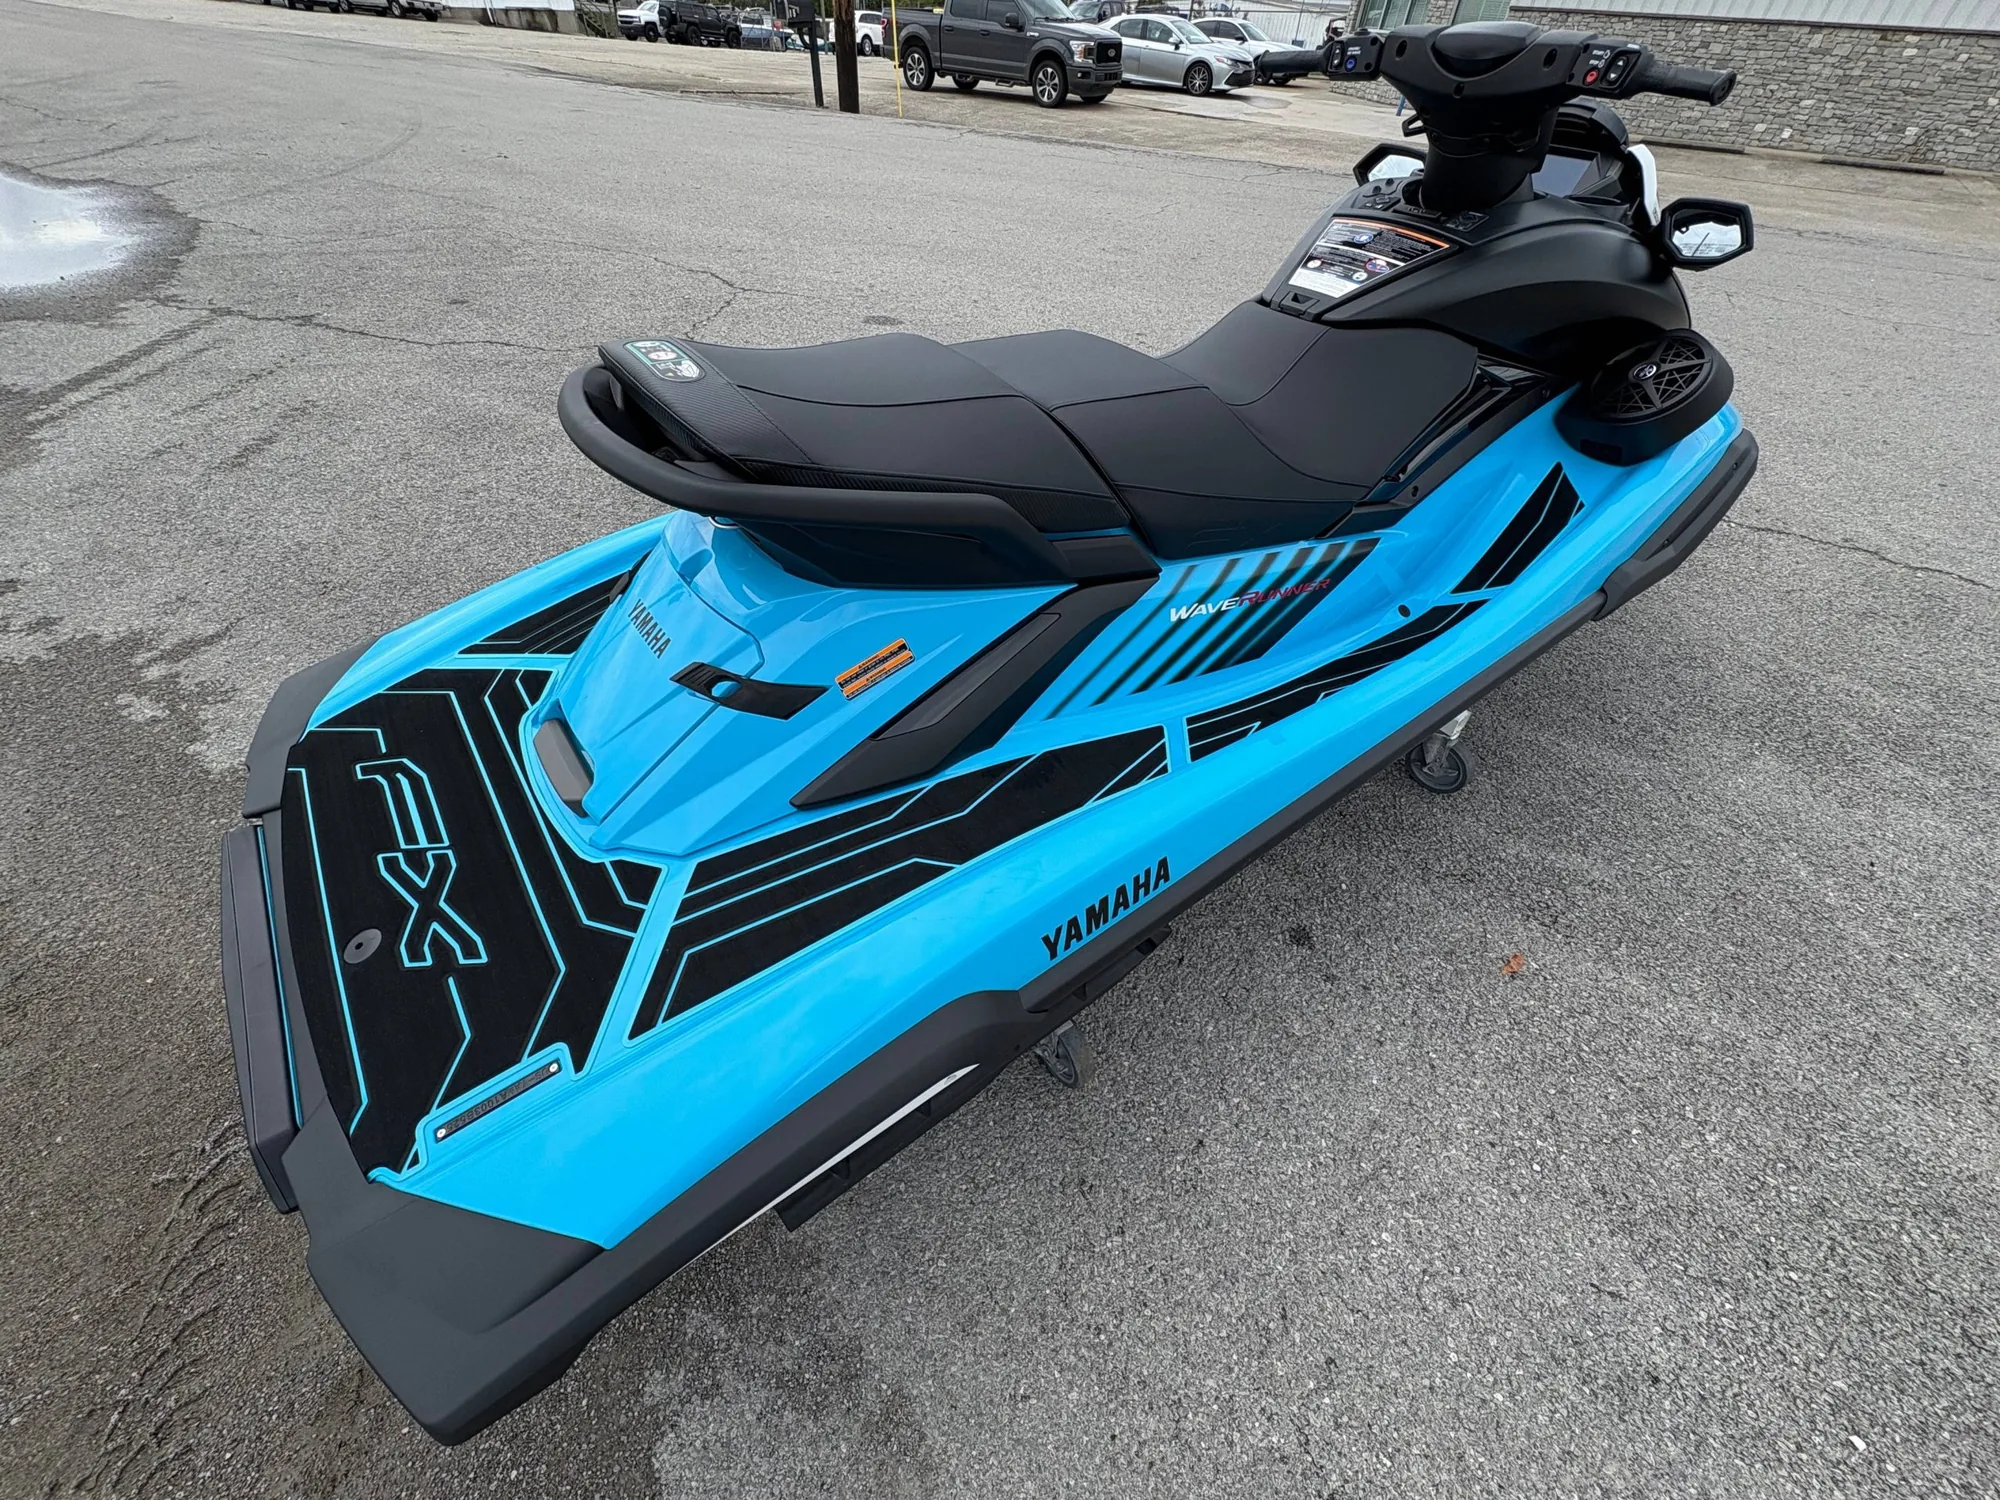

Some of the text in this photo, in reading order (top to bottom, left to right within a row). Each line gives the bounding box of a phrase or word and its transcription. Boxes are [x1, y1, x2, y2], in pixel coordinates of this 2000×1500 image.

[627, 598, 672, 660] YAMAHA
[1169, 578, 1332, 622] WAVERUNNER
[355, 758, 489, 968] FX
[1041, 856, 1171, 962] YAMAHA
